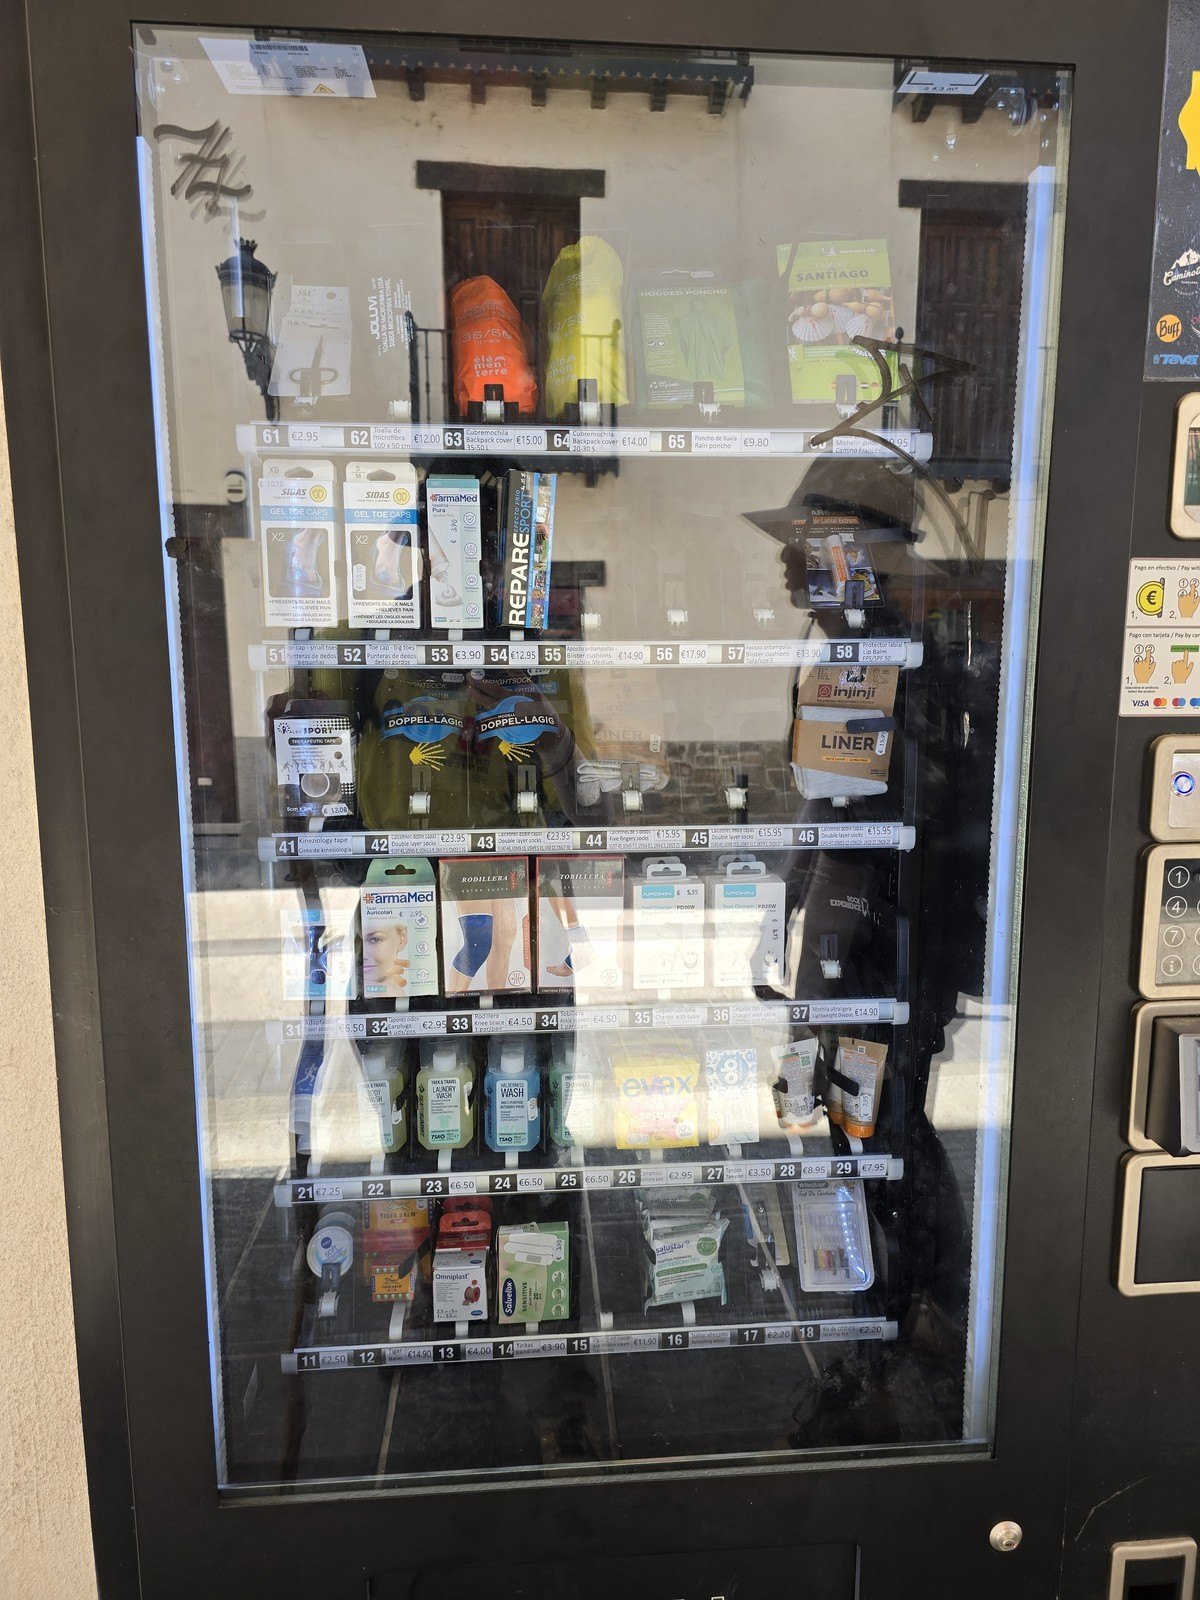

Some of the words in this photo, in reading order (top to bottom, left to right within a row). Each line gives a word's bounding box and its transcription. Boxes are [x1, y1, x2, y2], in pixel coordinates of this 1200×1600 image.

[816, 261, 848, 269] CAMINO
[796, 270, 869, 281] SANTIAGO
[641, 289, 682, 297] HOODED
[368, 296, 380, 340] JOLUVi
[1159, 319, 1181, 339] Buff
[1160, 354, 1199, 365] Teva
[475, 368, 508, 377] terre
[262, 429, 280, 444] 61
[291, 431, 319, 441] €2.95
[350, 430, 369, 445] 62
[414, 434, 440, 443] €12.00
[466, 429, 508, 437] Cubremochila
[444, 431, 463, 447] 63
[466, 436, 495, 444] Backpack
[516, 434, 543, 445] €15.00
[553, 433, 570, 447] 64
[621, 436, 648, 446] €14.00
[668, 434, 685, 449] 65
[743, 437, 769, 447] €9.80
[709, 443, 732, 451] poncho
[281, 488, 307, 496] SIDAS
[365, 491, 390, 499] SIDAS
[435, 494, 478, 502] FarmaMed
[270, 507, 287, 516] GEL
[289, 507, 305, 516] TOE
[307, 508, 329, 516] CAPS
[353, 510, 371, 518] GEL
[372, 510, 388, 519] TOE
[390, 510, 411, 519] CAPS
[272, 532, 285, 542] X2
[355, 535, 368, 545] X2
[508, 532, 530, 625] REPARE
[519, 491, 531, 533] SPORT
[1134, 564, 1147, 572] Pago
[269, 648, 286, 662] 51
[343, 648, 361, 662] 52
[431, 648, 449, 662] 53
[455, 650, 481, 660] €3.90
[490, 648, 508, 662] 54
[510, 650, 536, 660] €12.95
[544, 648, 562, 662] 55
[618, 651, 644, 661] €14.90
[656, 647, 674, 661] 56
[681, 649, 706, 659] €17.90
[728, 646, 745, 660] 57
[796, 649, 821, 659] €13.90
[836, 645, 853, 659] 58
[833, 685, 877, 700] injinji
[388, 716, 464, 729] DOPPEL-LAGIG
[481, 715, 555, 731] DOPPEL-LAGIG
[821, 734, 876, 751] LINER
[546, 831, 571, 841] €23.95
[656, 829, 681, 839] €15.95
[758, 828, 782, 838] €15.95
[798, 829, 815, 843] 46
[867, 826, 892, 836] €15.95
[441, 833, 466, 843] €23.95
[476, 836, 494, 850] 43
[585, 834, 603, 847] 44
[622, 836, 637, 844] fingers
[691, 831, 708, 845] 45
[279, 840, 295, 854] 41
[370, 838, 388, 852] 42
[462, 875, 508, 883] RODILLERA
[560, 873, 605, 881] TOBILLERA
[1175, 870, 1182, 884] 1
[370, 891, 434, 904] FarmaMed
[829, 899, 862, 912] EXPERIENCE
[1171, 900, 1181, 914] 4
[1170, 930, 1179, 943] 7
[634, 1010, 650, 1024] 35
[713, 1009, 729, 1022] 36
[792, 1006, 808, 1020] 37
[854, 1007, 879, 1017] €14.90
[422, 1019, 448, 1029] €2.95
[452, 1017, 469, 1031] 33
[508, 1017, 533, 1026] €4.50
[540, 1014, 557, 1027] 34
[593, 1014, 617, 1024] €4.50
[285, 1023, 301, 1037] 31
[339, 1022, 365, 1032] €6.50
[372, 1020, 388, 1033] 32
[432, 1085, 456, 1093] LAUNDRY
[622, 1075, 692, 1098] evax
[436, 1092, 452, 1100] WASH
[500, 1087, 524, 1098] WASH
[748, 1166, 772, 1177] €3.50
[779, 1164, 796, 1177] 28
[803, 1165, 826, 1175] €8.95
[836, 1161, 852, 1174] 29
[861, 1162, 885, 1172] €7.95
[585, 1173, 609, 1184] €6.50
[618, 1170, 636, 1184] 26
[668, 1170, 693, 1180] €2.95
[707, 1167, 723, 1180] 27
[450, 1180, 475, 1190] €6.50
[494, 1177, 511, 1190] 24
[519, 1177, 543, 1187] €6.50
[561, 1174, 577, 1186] 25
[316, 1186, 340, 1197] €7.25
[367, 1183, 384, 1196] 22
[426, 1180, 442, 1193] 23
[297, 1186, 313, 1199] 21
[655, 1243, 686, 1254] salustar
[435, 1273, 468, 1282] Omniplast
[767, 1330, 791, 1340] €2.20
[799, 1326, 814, 1339] 18
[860, 1325, 882, 1335] €2.20
[667, 1334, 683, 1347] 16
[743, 1330, 758, 1342] 17
[542, 1341, 565, 1352] €3.90
[572, 1339, 588, 1352] 15
[634, 1338, 657, 1347] €11.90
[407, 1349, 431, 1359] €14.90
[438, 1346, 454, 1360] 13
[467, 1345, 491, 1356] €4.00
[498, 1343, 514, 1356] 14
[301, 1355, 316, 1367] 11
[322, 1354, 346, 1364] €2.50
[359, 1351, 375, 1363] 12
